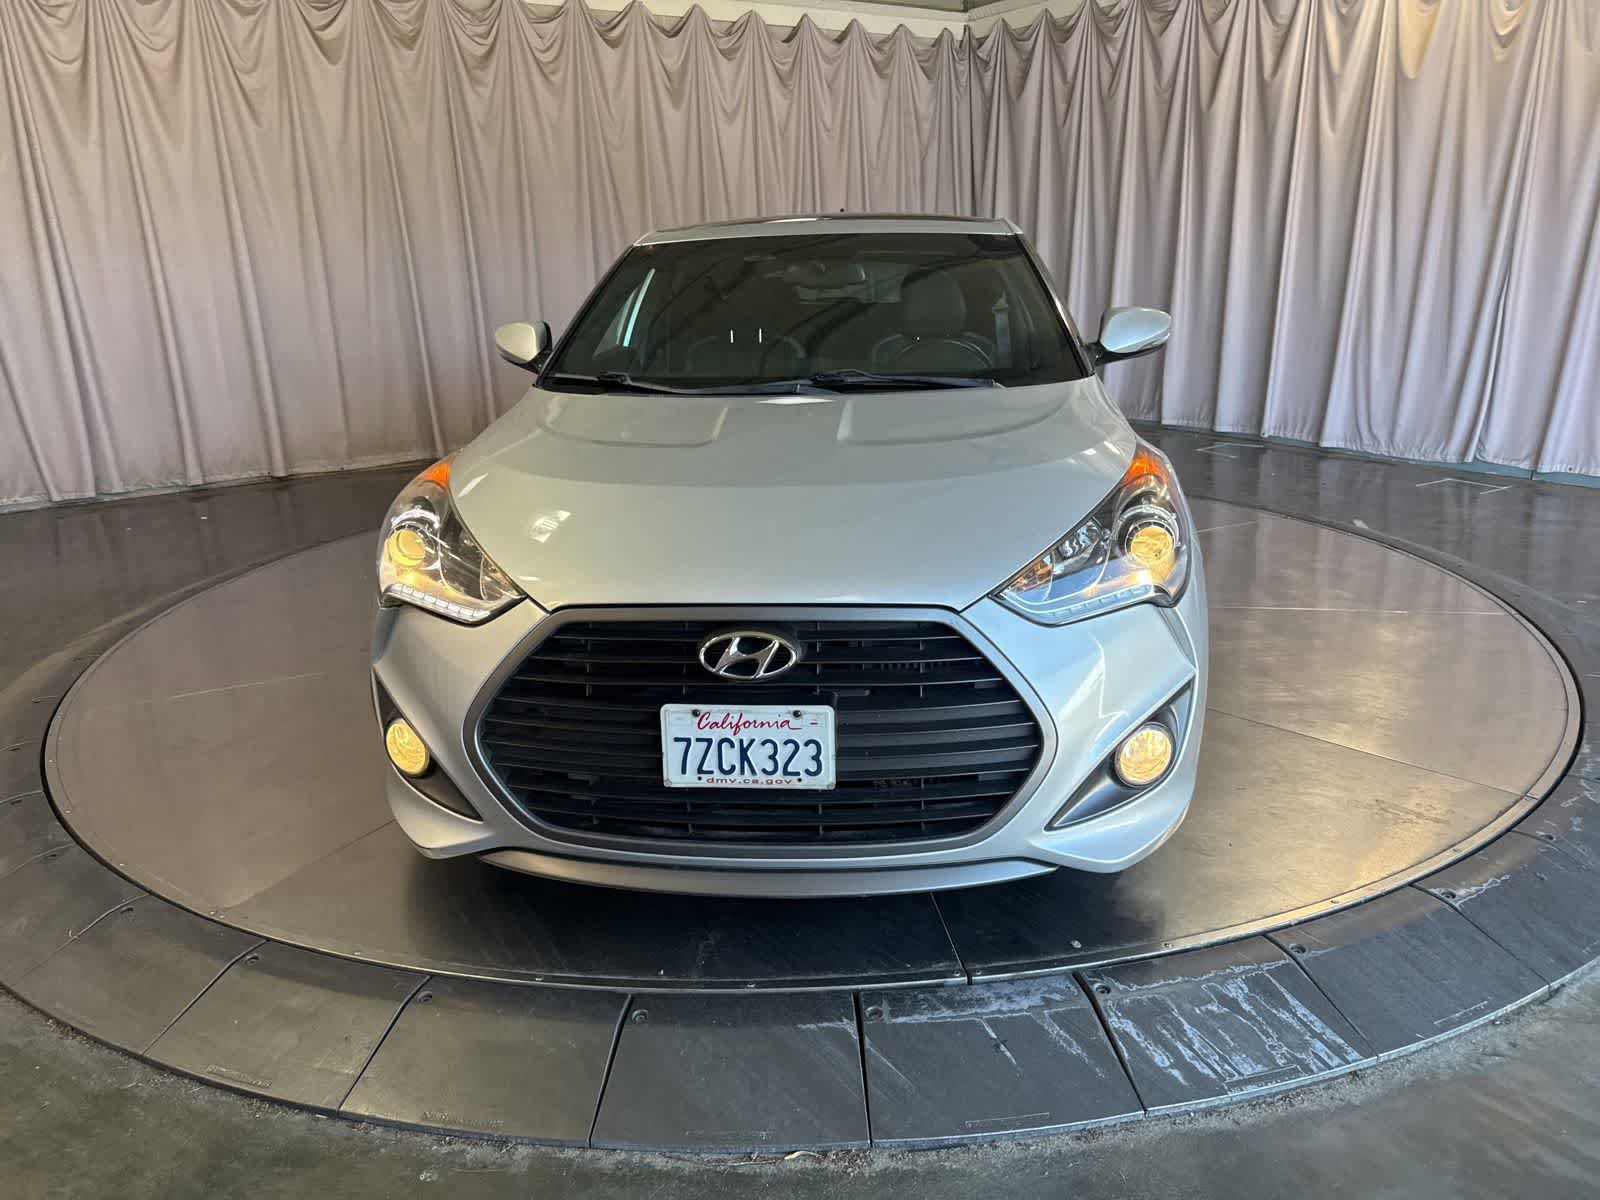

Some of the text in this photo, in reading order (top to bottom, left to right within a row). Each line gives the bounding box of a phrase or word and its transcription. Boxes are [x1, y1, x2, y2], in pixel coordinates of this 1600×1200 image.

[696, 711, 802, 736] California
[673, 736, 823, 776] 7ZCK323
[706, 776, 792, 785] dmv.ca.gov
